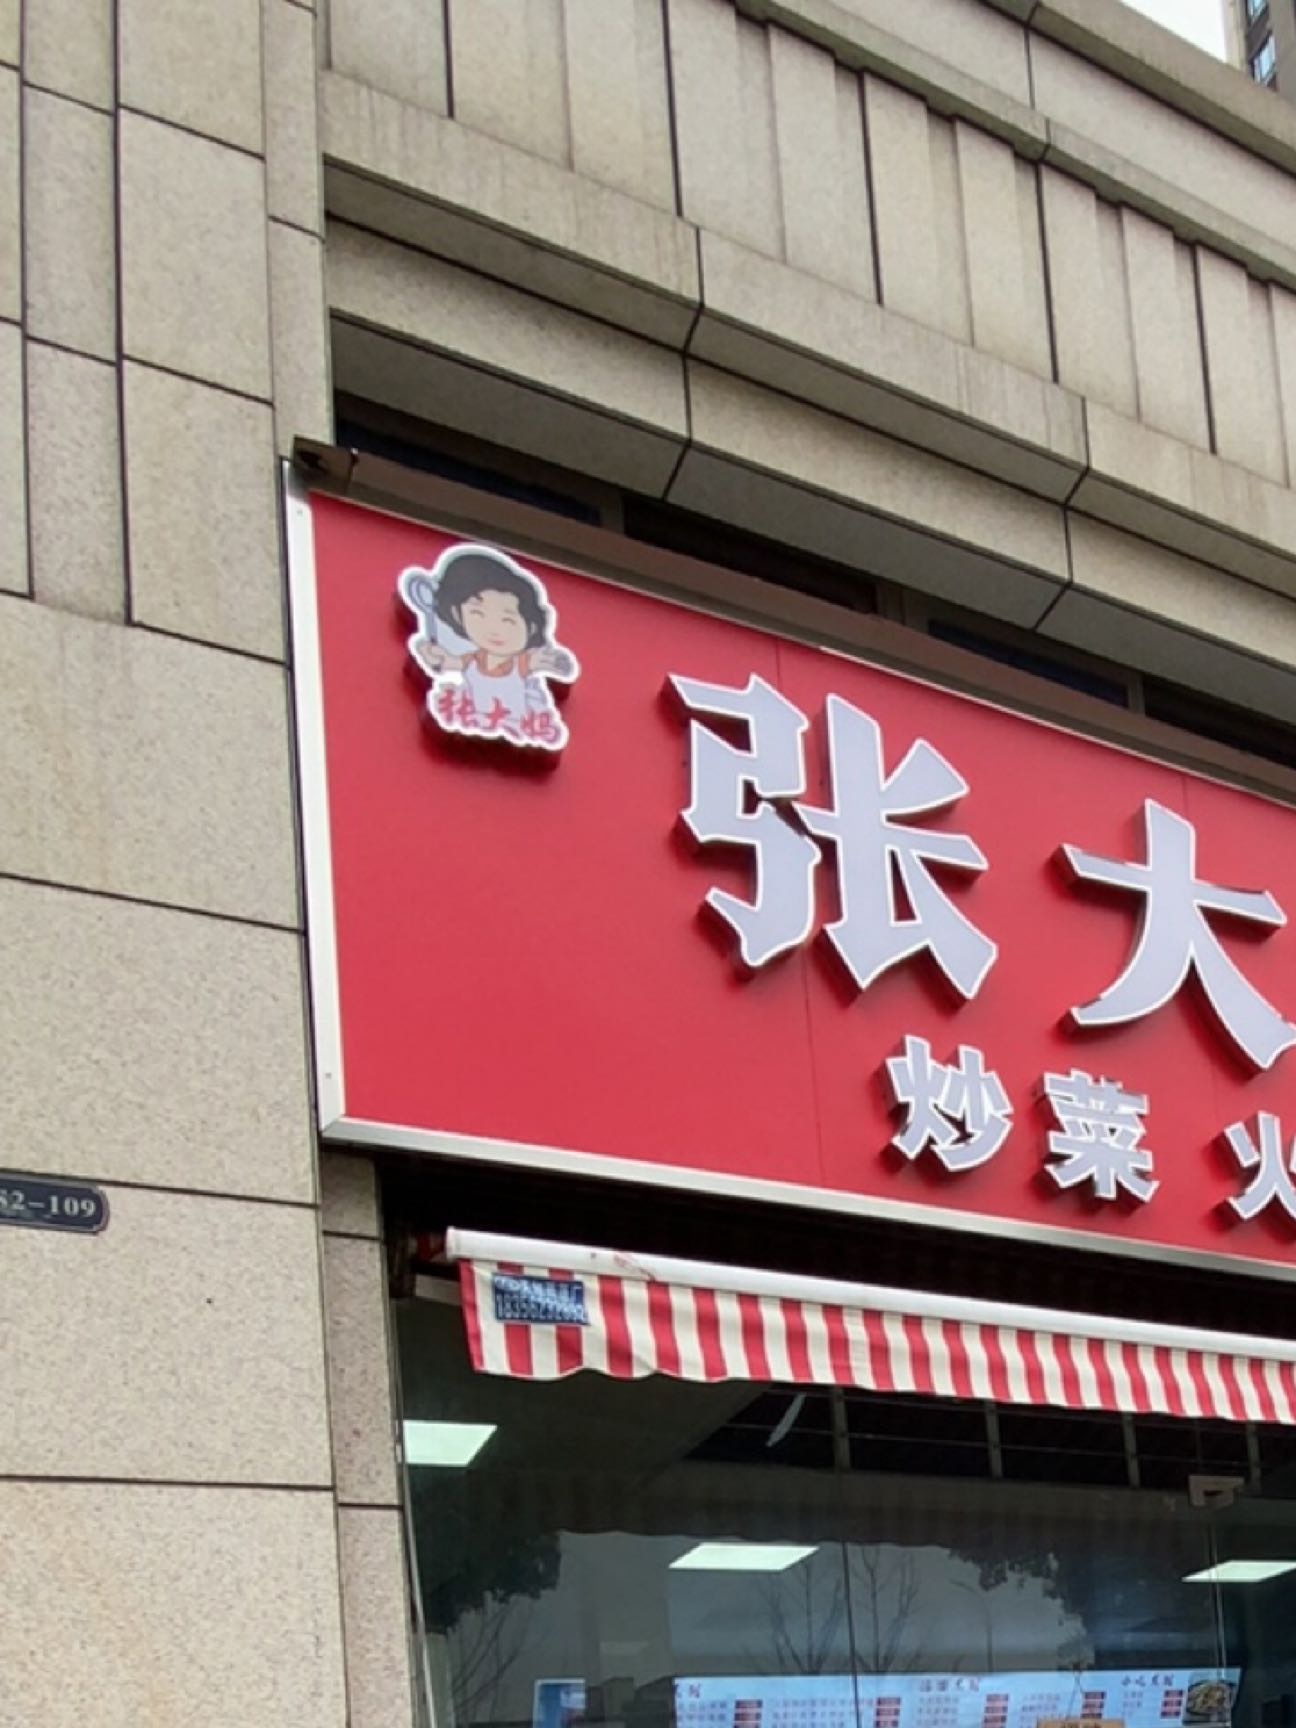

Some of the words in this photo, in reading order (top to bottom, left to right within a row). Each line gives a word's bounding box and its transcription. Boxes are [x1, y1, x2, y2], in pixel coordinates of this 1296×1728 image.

[438, 687, 562, 744] 张大妈
[893, 1036, 1159, 1203] 炒菜
